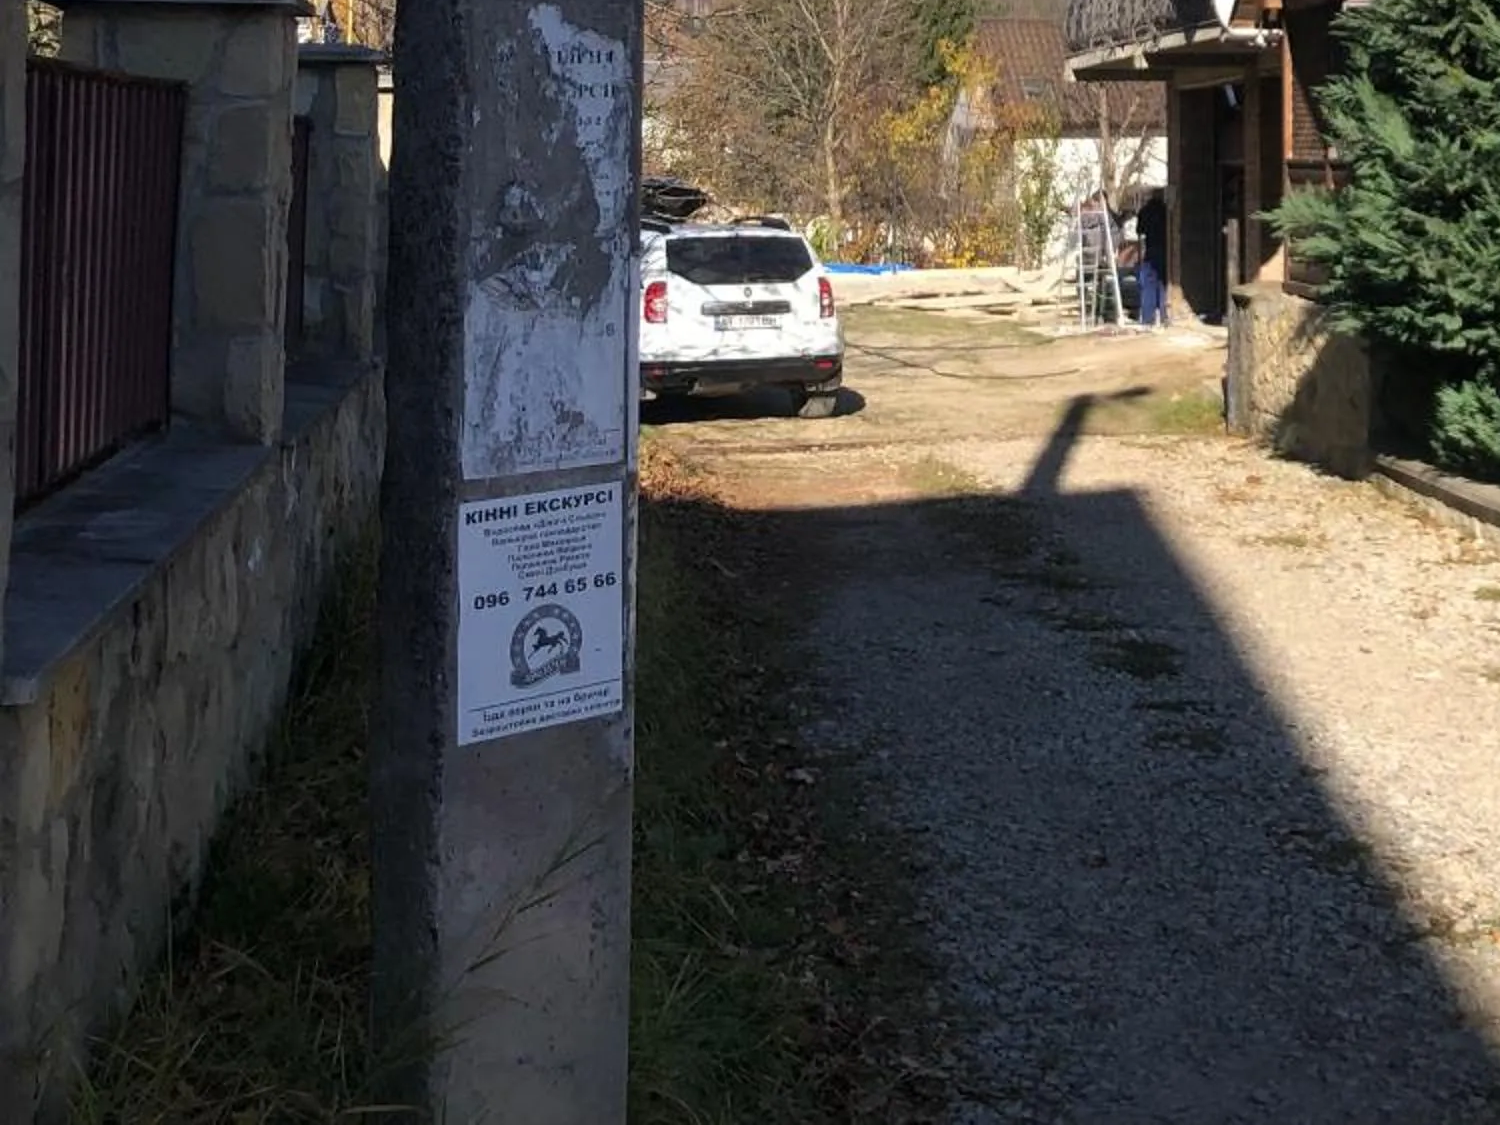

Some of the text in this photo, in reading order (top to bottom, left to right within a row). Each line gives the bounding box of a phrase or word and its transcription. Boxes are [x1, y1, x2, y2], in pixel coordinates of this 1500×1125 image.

[464, 504, 518, 526] КІННІ
[473, 591, 510, 610] 096
[522, 582, 558, 602] 744
[564, 576, 587, 594] 65
[593, 571, 617, 588] 66
